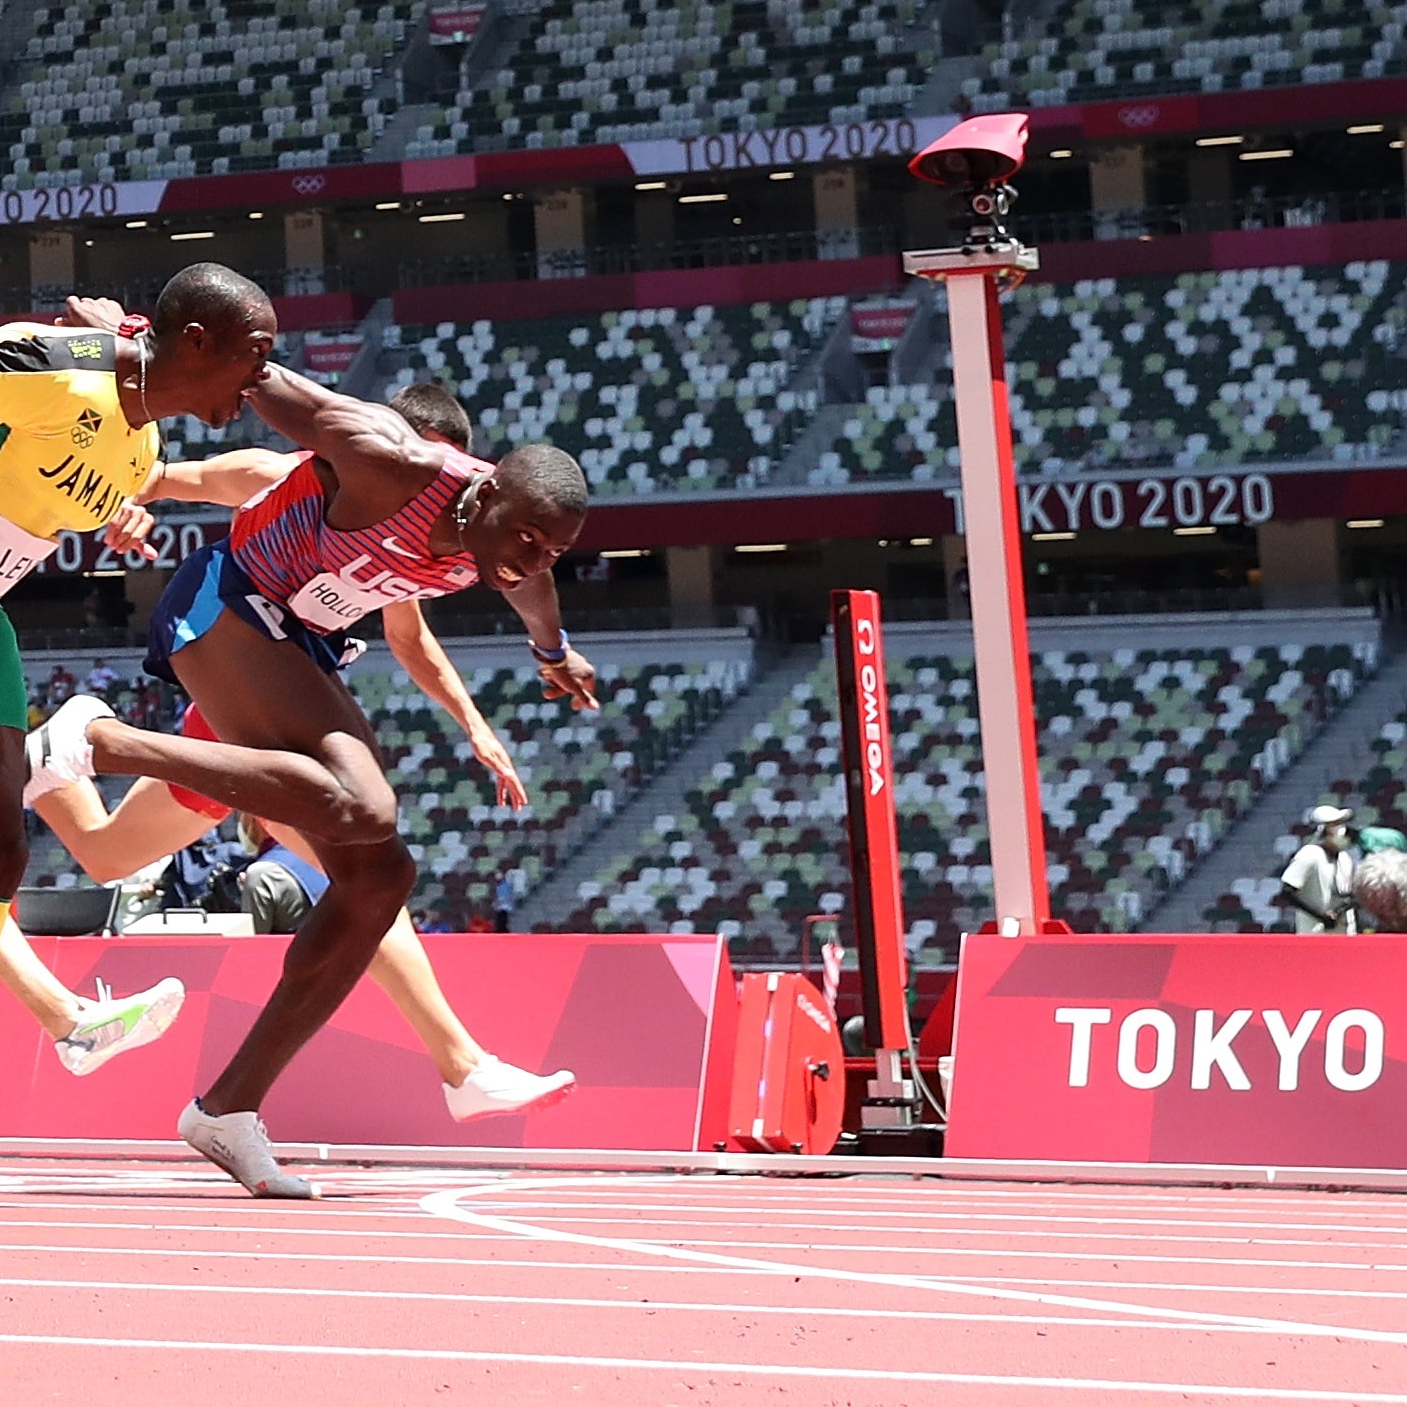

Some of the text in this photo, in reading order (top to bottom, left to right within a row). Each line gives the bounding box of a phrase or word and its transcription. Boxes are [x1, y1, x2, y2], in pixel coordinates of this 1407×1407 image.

[680, 120, 918, 172] TOKYO 2020
[34, 183, 117, 221] 2020
[38, 454, 125, 523] JAMAI
[942, 476, 1274, 534] TKYO 2020
[310, 582, 365, 618] HOLLO
[340, 554, 447, 603] USA
[861, 665, 885, 796] OMEGA
[1055, 1007, 1385, 1092] TOKYO
